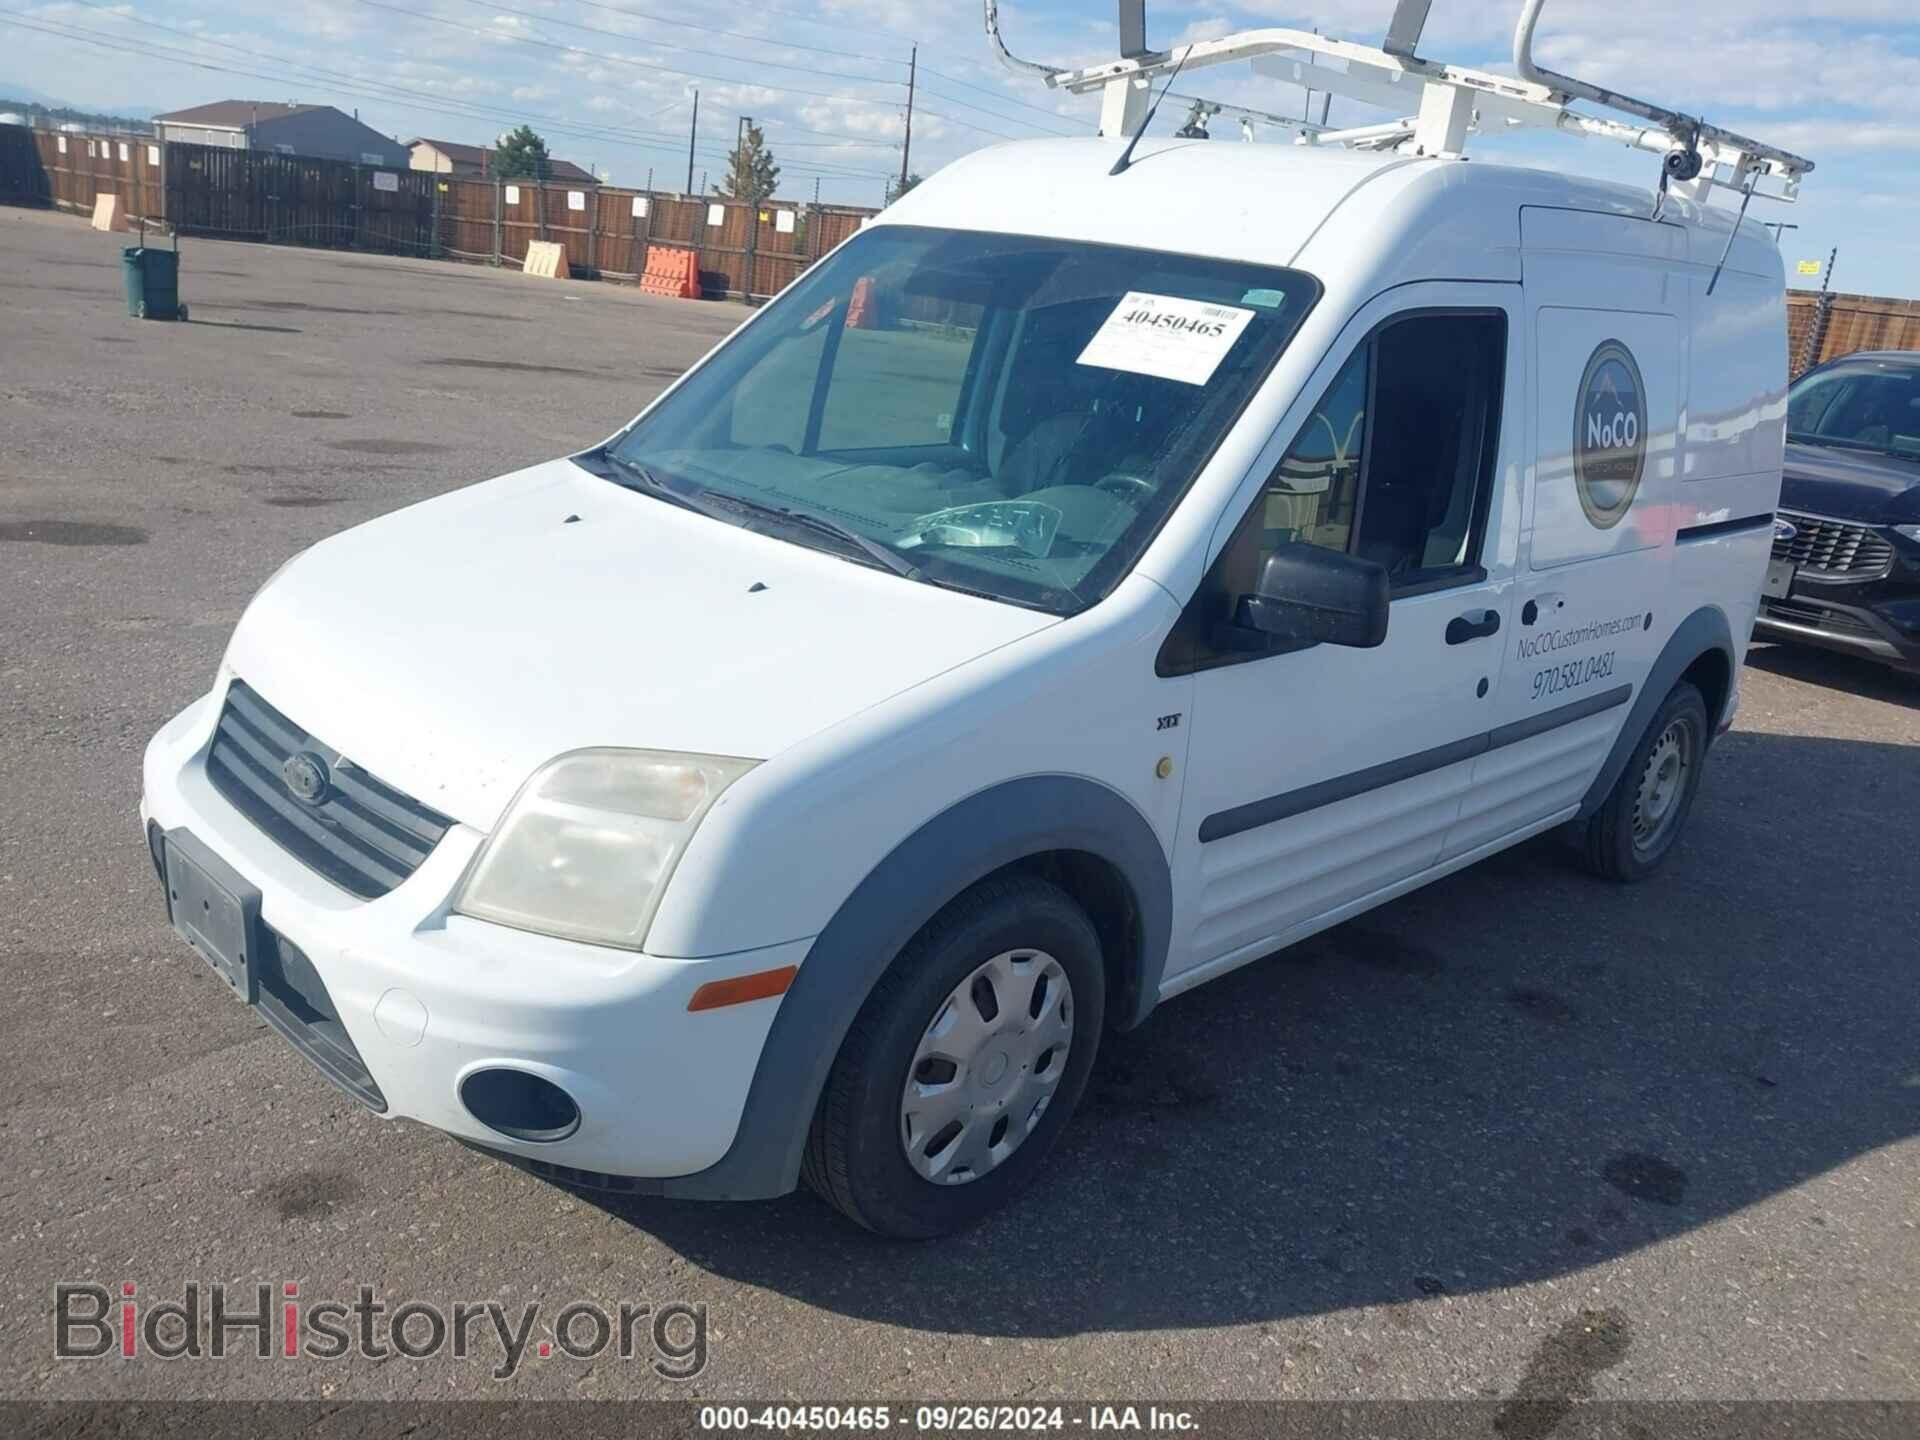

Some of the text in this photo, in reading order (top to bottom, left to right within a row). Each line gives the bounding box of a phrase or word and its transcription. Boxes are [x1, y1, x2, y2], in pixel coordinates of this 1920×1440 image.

[1123, 309, 1227, 338] 40450465
[1587, 411, 1638, 448] NoCO
[1516, 613, 1642, 660] NoCOCustomHomes.com
[1531, 650, 1616, 700] 970.581.0481
